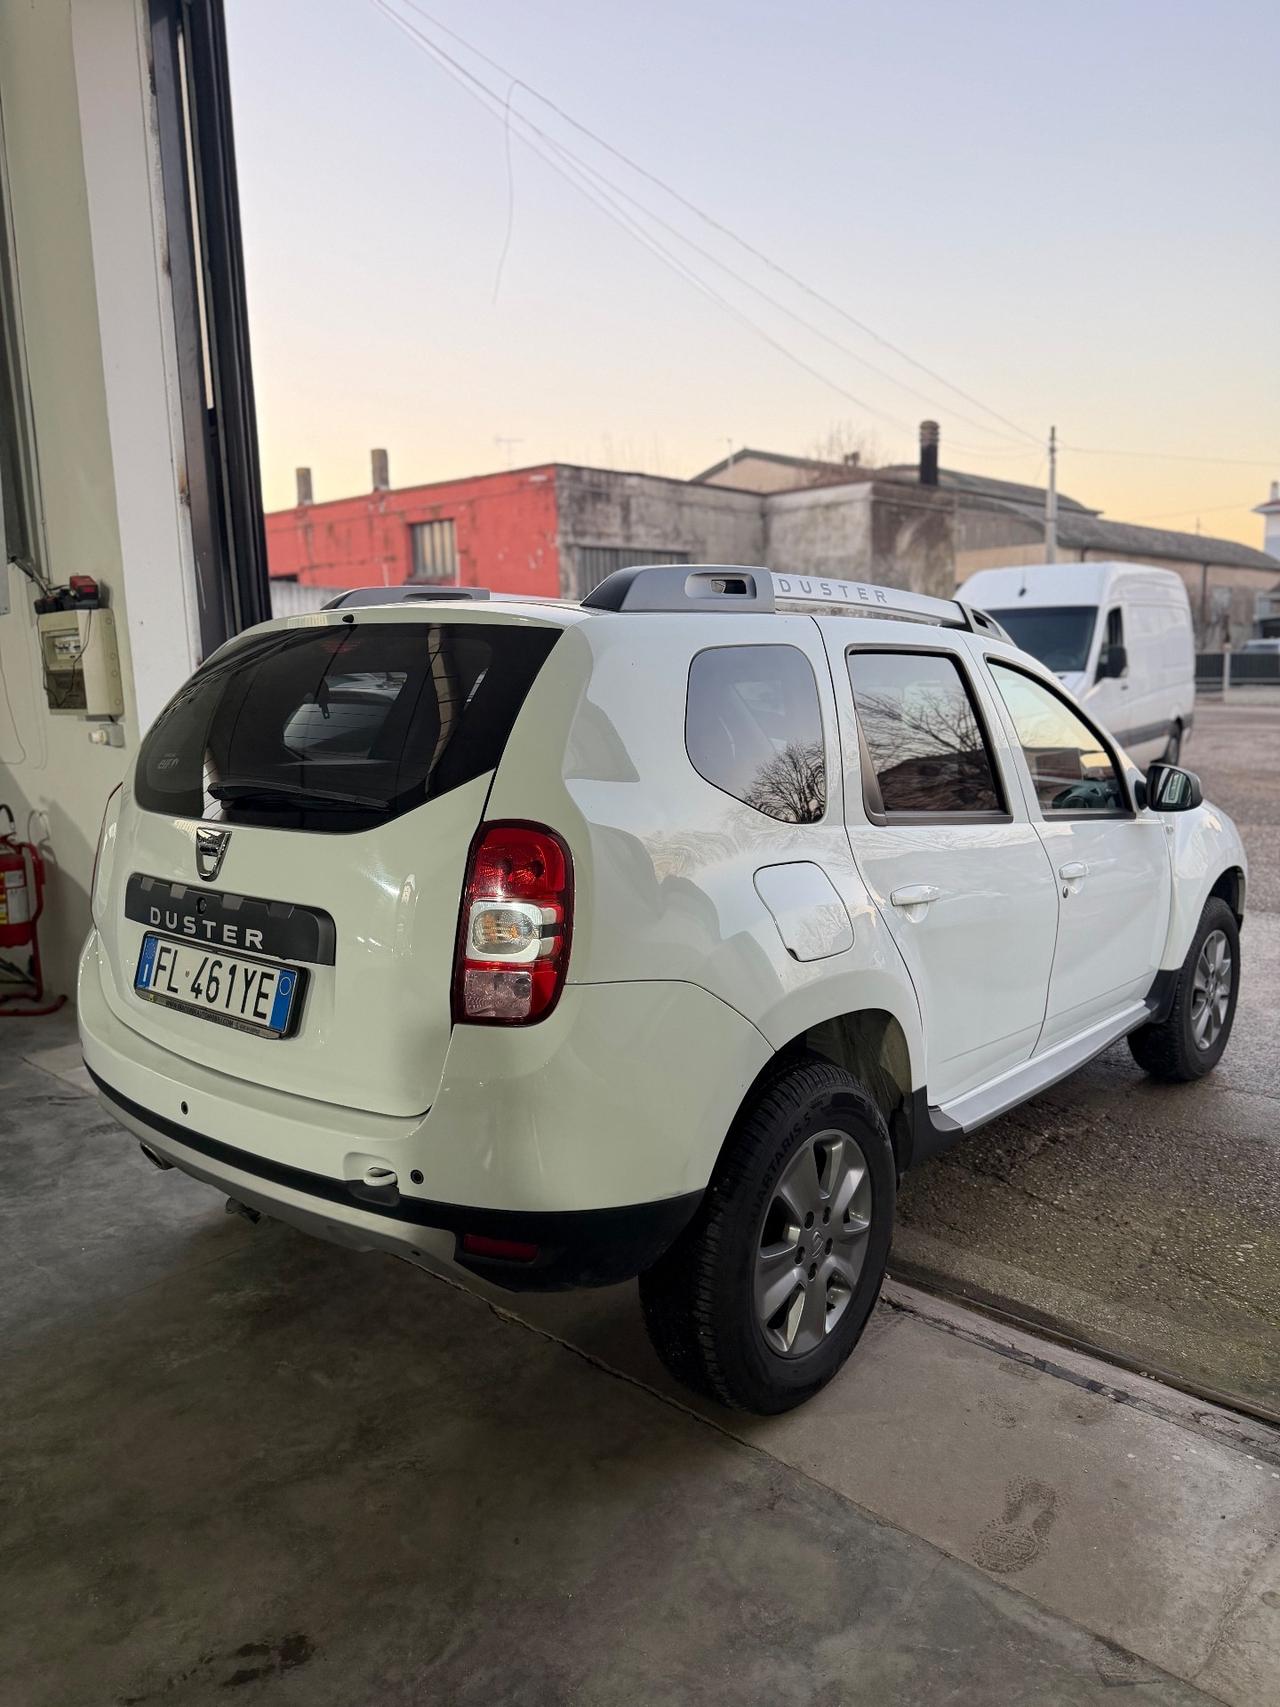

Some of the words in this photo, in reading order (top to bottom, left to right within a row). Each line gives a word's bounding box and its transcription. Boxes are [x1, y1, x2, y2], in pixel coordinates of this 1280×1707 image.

[778, 578, 888, 604] DUSTER
[150, 906, 264, 950] DUSTER
[142, 963, 149, 982] I
[152, 945, 179, 994] FL
[190, 956, 276, 1020] 461YE
